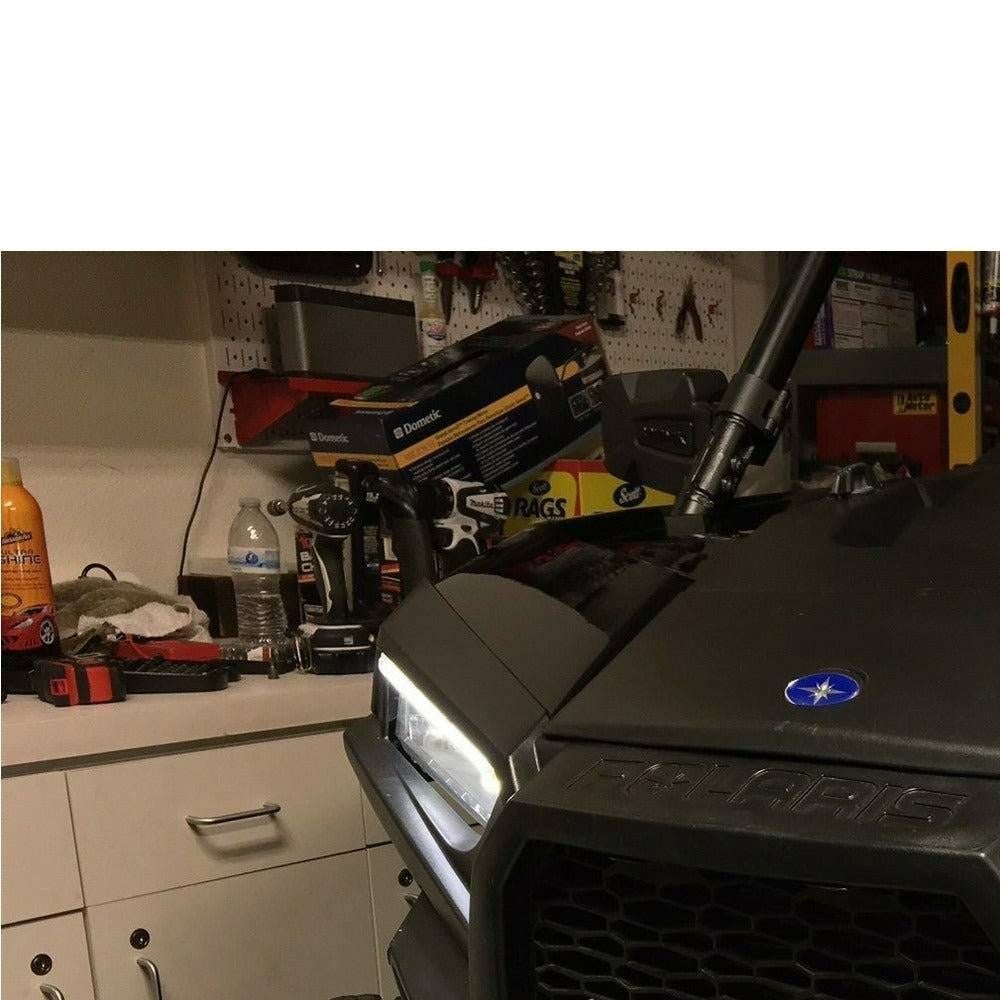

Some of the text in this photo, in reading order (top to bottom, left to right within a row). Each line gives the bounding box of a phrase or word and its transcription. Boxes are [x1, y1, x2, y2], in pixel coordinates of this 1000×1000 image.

[403, 408, 442, 435] Dometic
[514, 497, 567, 518] RAGS
[563, 756, 970, 824] POLARIS
